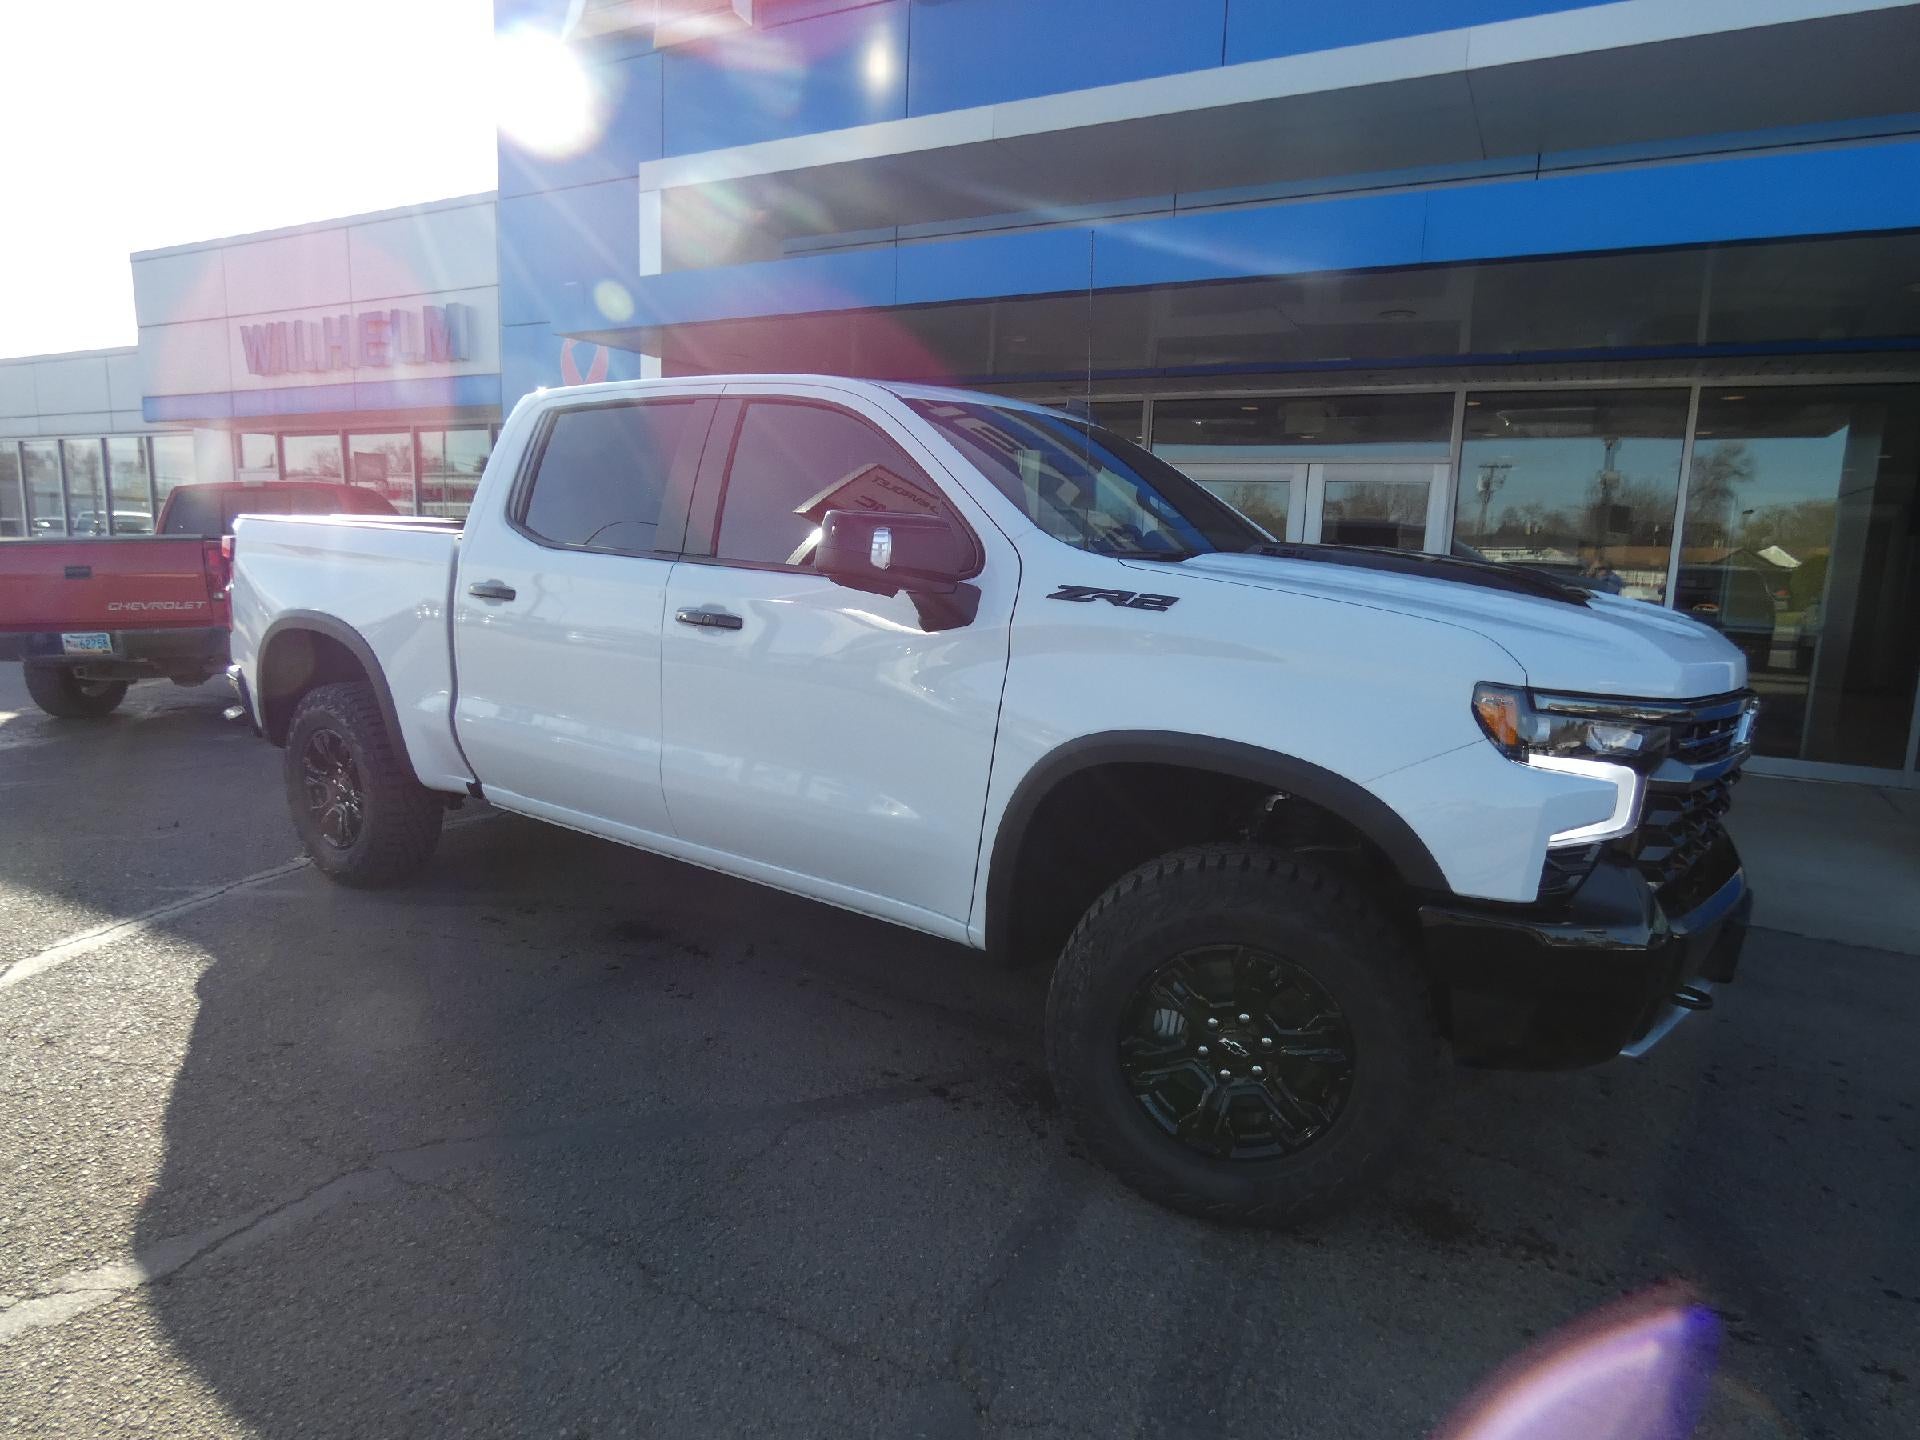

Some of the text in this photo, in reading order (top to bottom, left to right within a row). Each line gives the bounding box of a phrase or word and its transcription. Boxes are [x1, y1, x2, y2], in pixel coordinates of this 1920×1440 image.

[240, 303, 472, 376] WILHELM
[107, 600, 208, 611] CHEVROLET
[1046, 585, 1180, 612] ZR2
